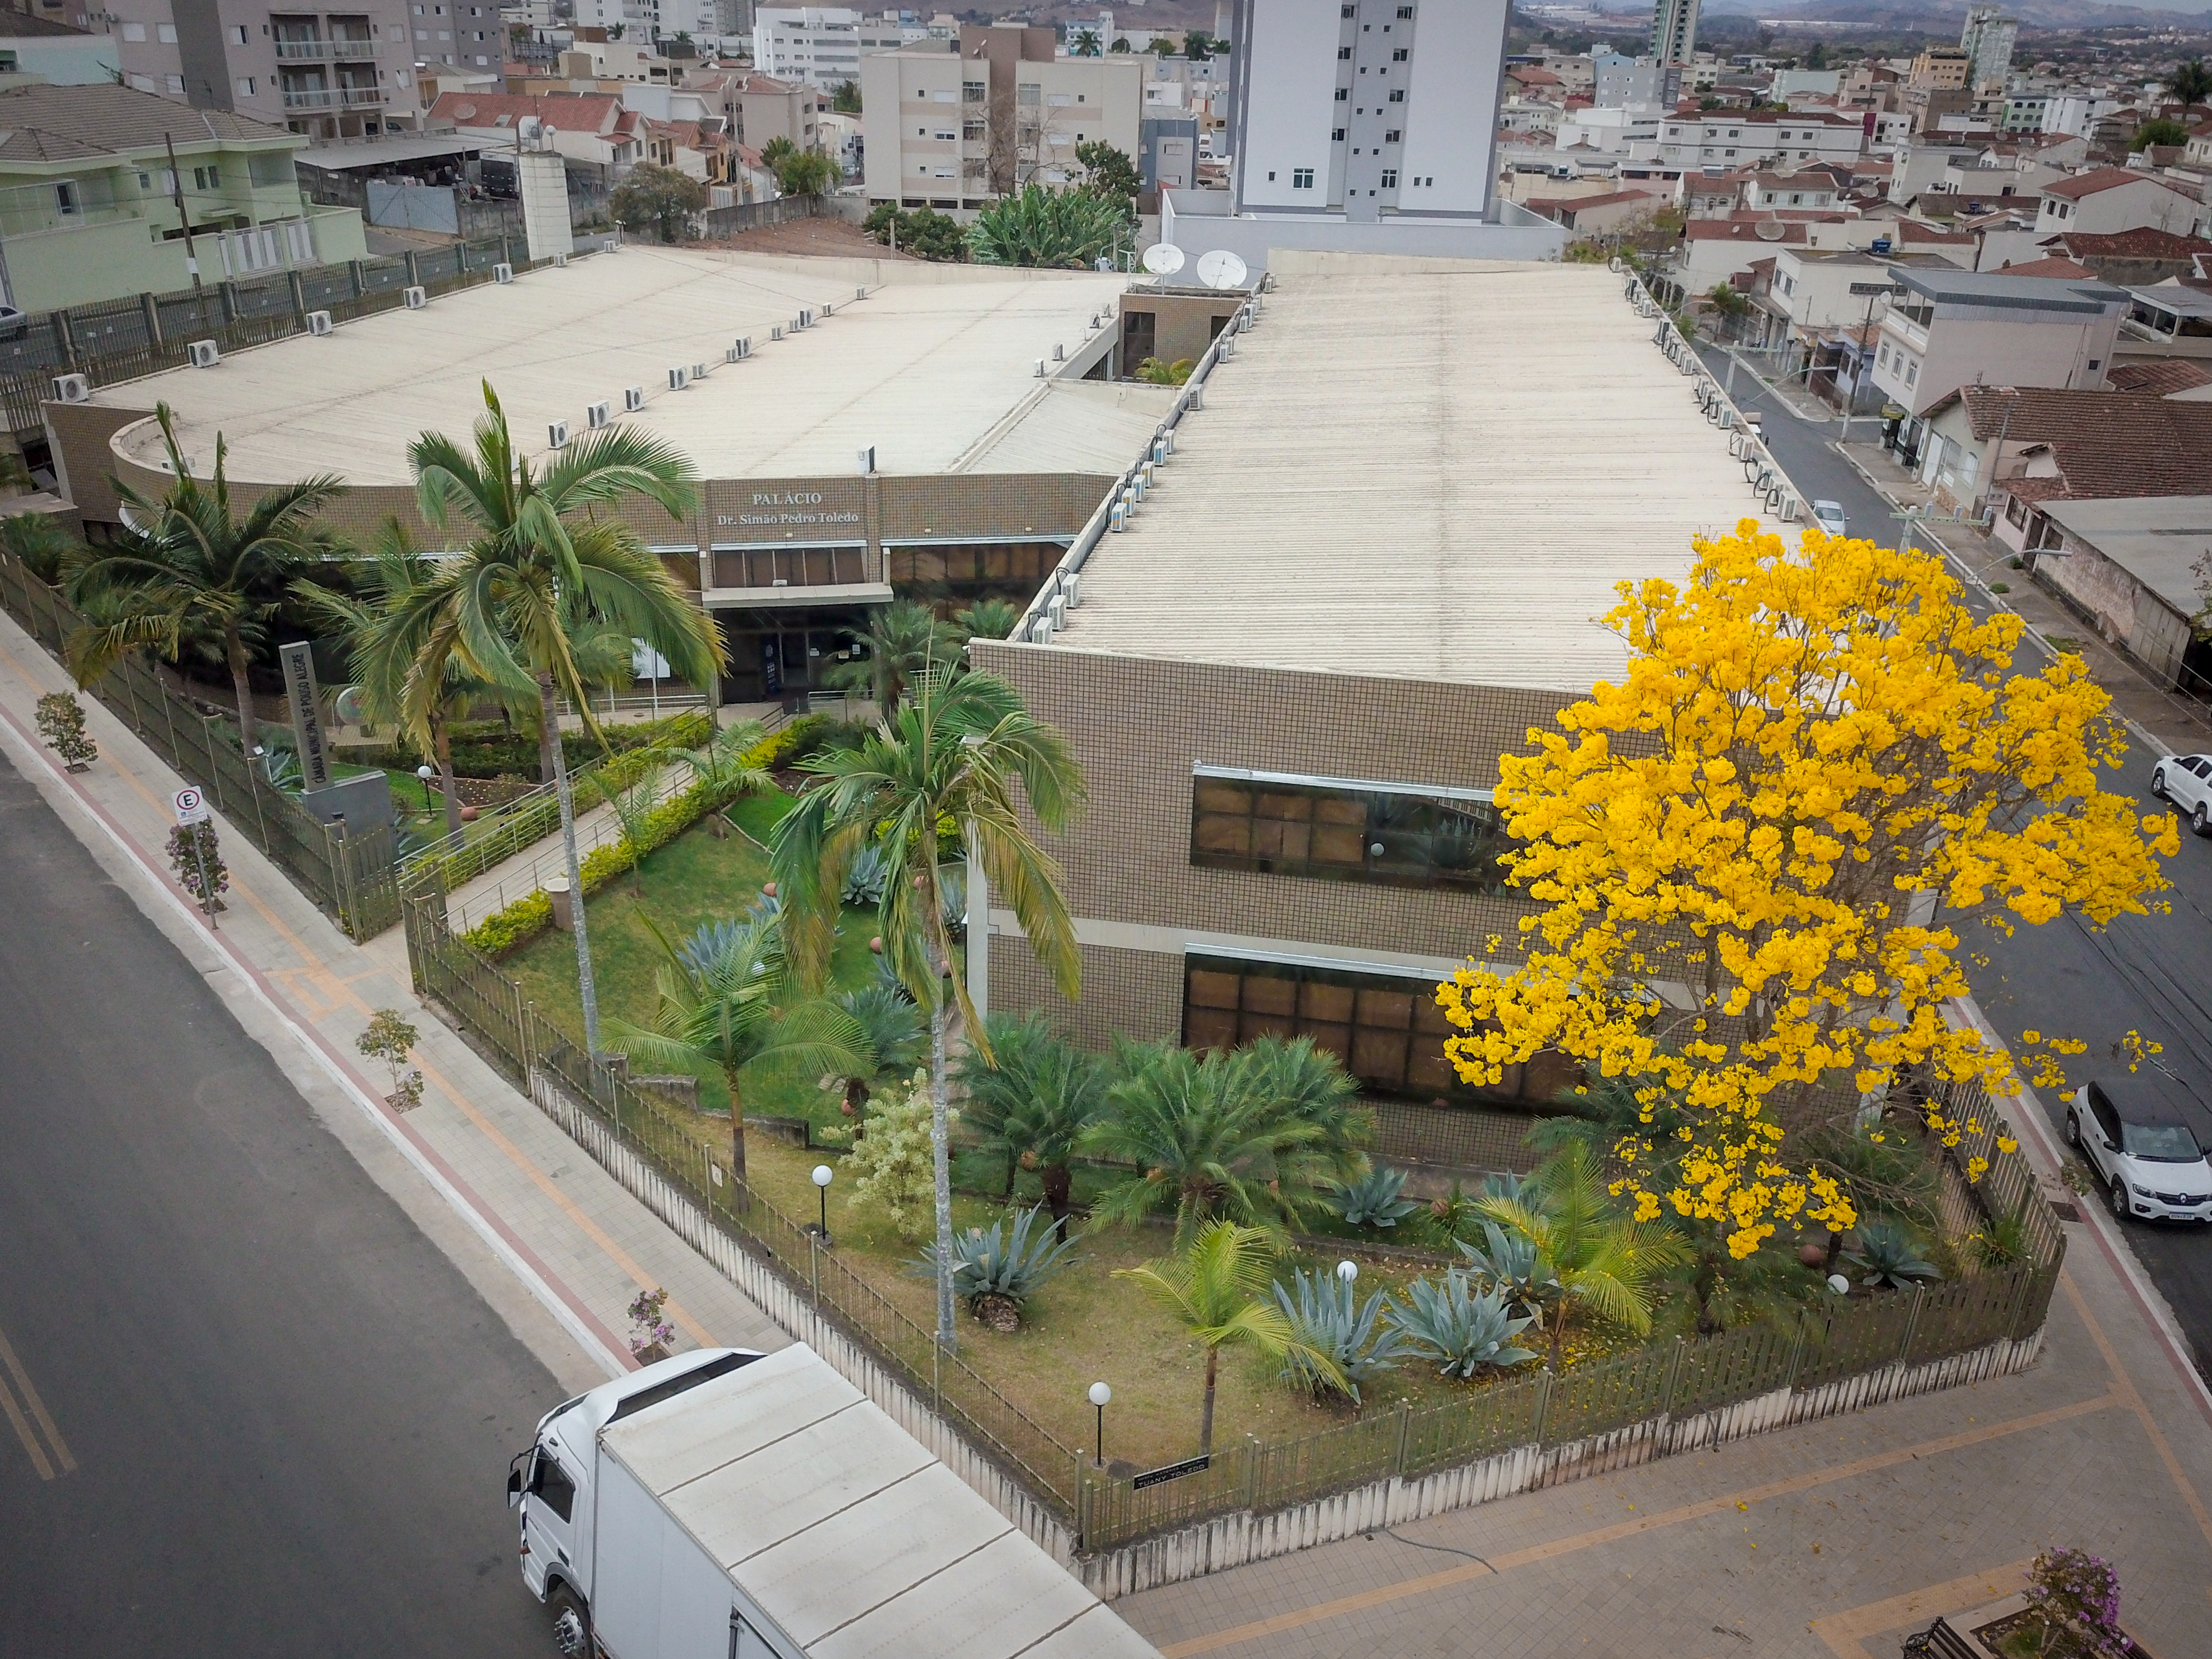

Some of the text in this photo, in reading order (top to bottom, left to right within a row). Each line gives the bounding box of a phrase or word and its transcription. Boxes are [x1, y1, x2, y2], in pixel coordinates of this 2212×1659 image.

[752, 491, 822, 505] PALÁCIO
[718, 512, 859, 526] Dr. Simão Pedro Toledo
[291, 653, 308, 680] ALEGRE
[297, 682, 312, 707] POUSO
[303, 707, 314, 718] DE
[305, 718, 322, 754] MUNICIPAL
[183, 794, 193, 806] E
[1138, 1464, 1205, 1488] TUANY TOLEDO
